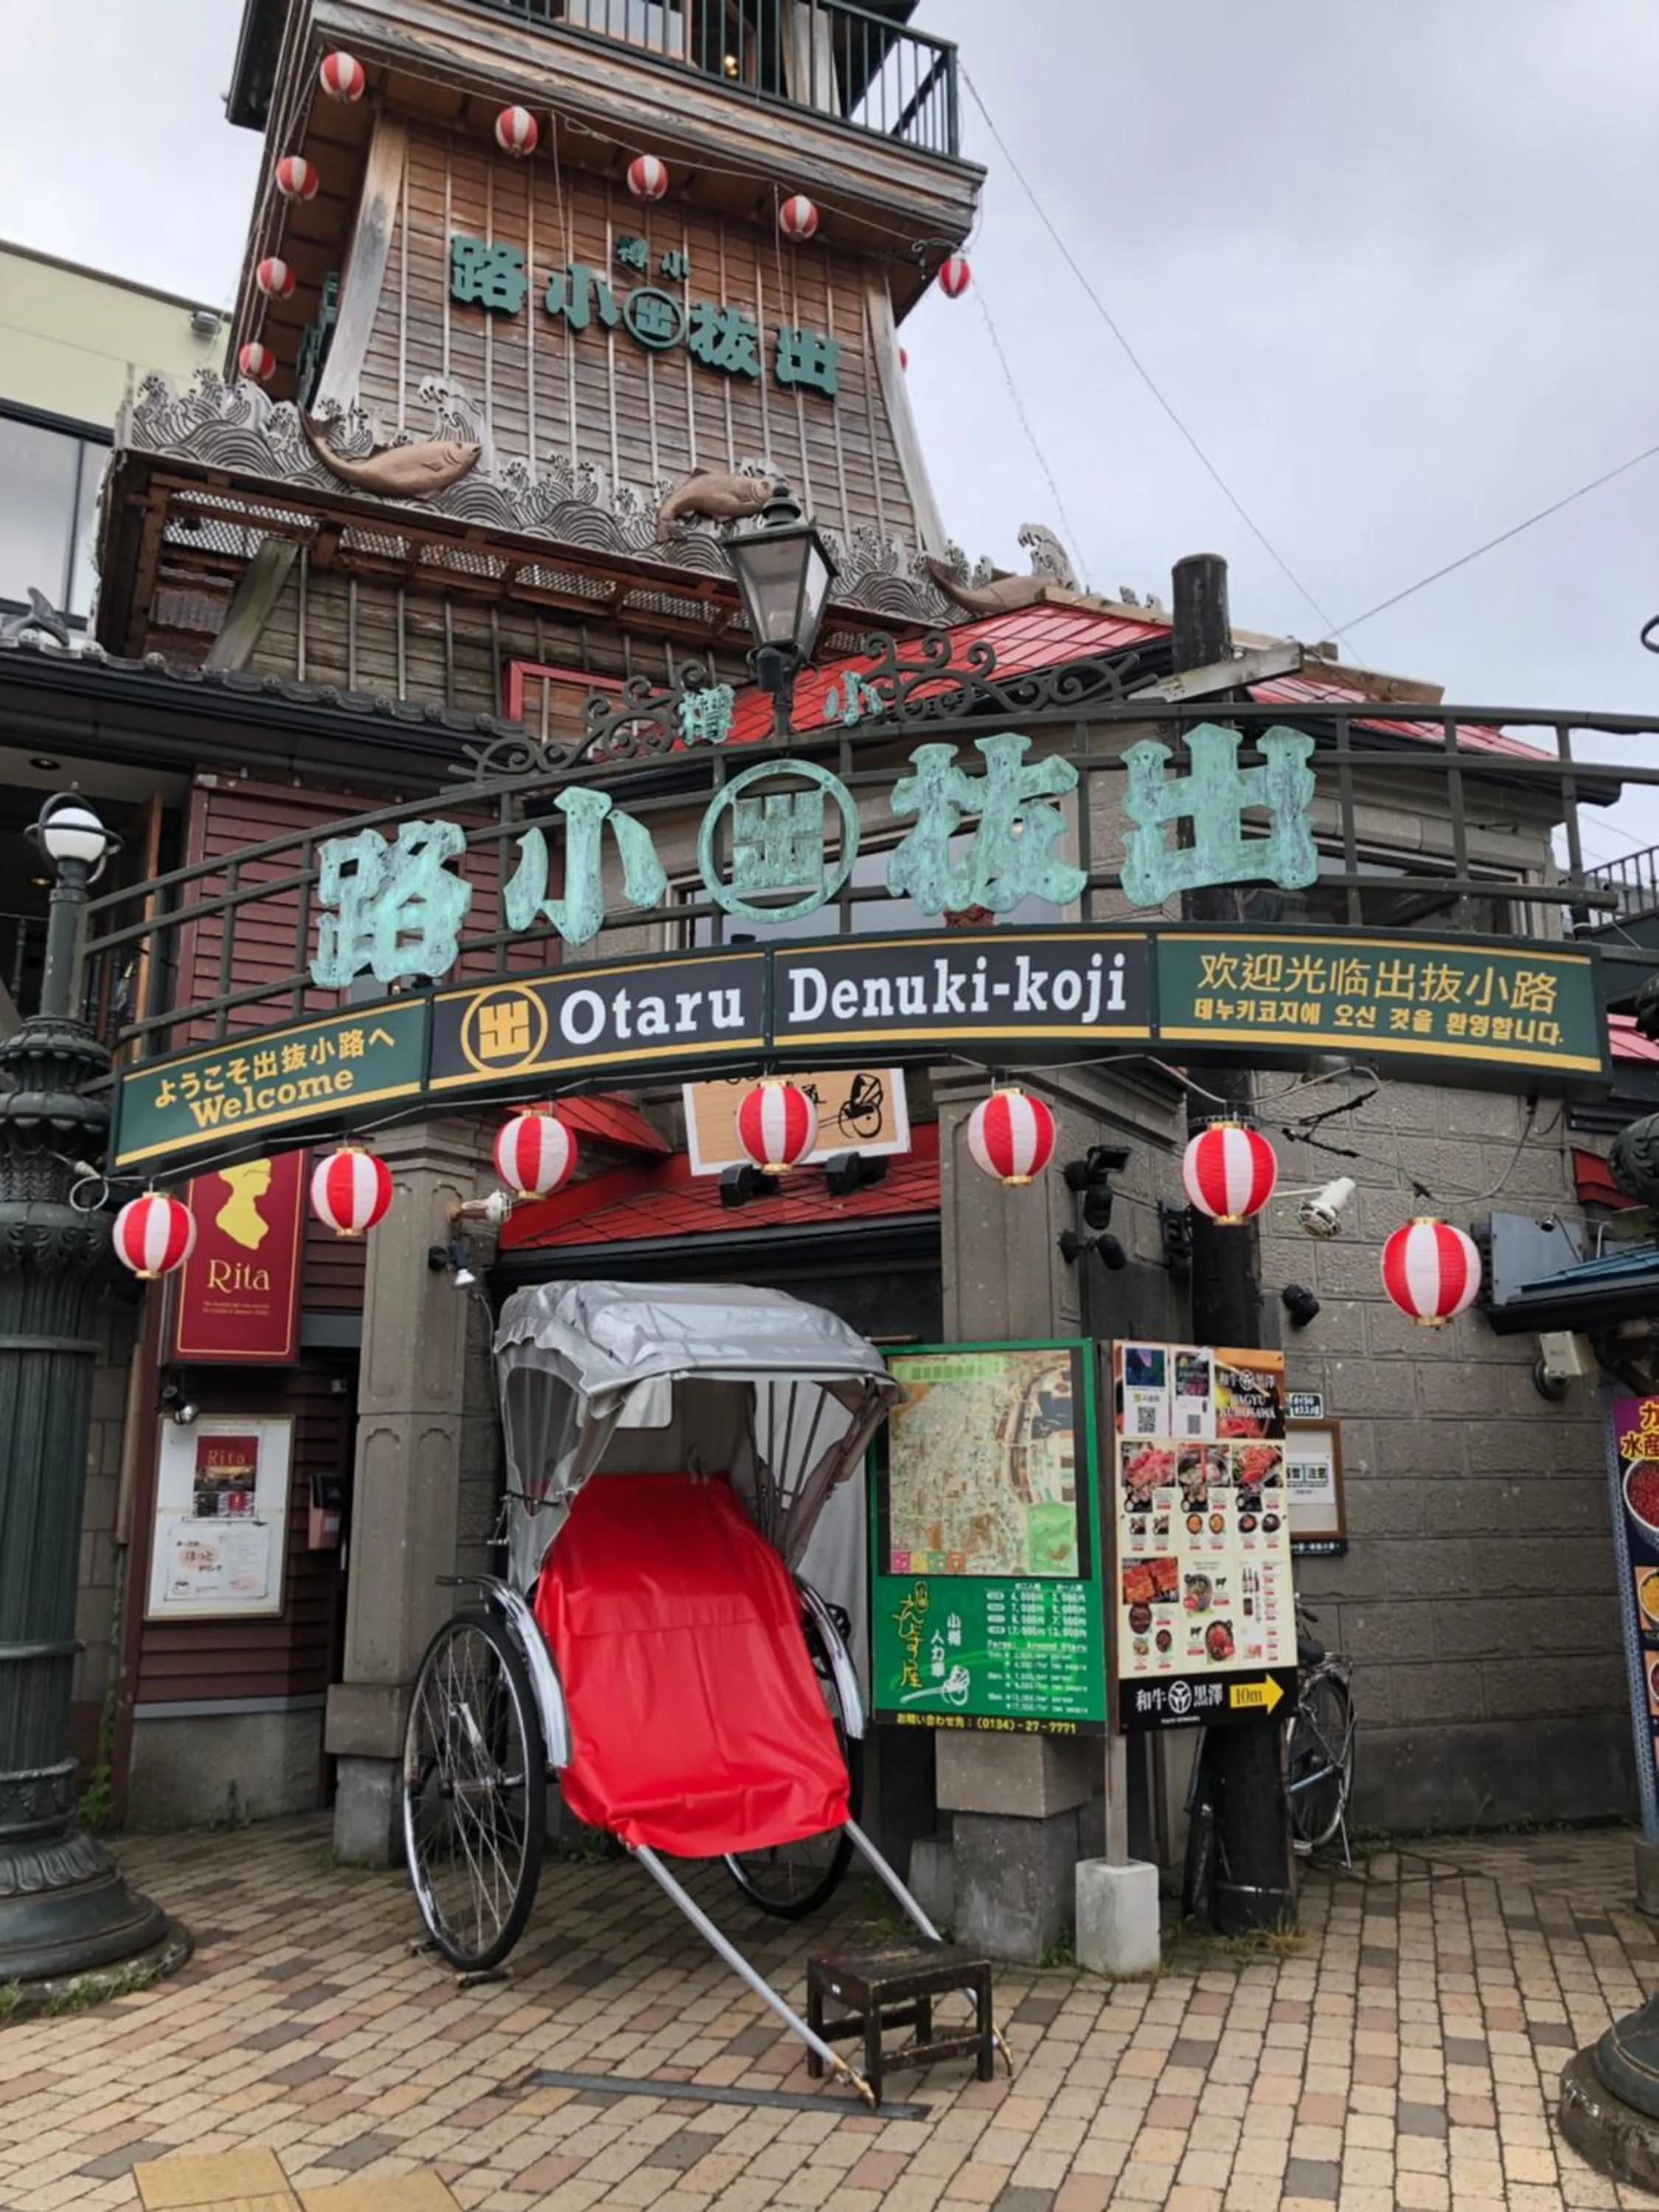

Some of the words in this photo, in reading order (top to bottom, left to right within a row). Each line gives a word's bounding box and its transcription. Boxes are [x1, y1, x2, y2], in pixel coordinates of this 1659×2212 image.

[560, 986, 745, 1046] Otaru
[787, 952, 1127, 1023] Denuki-koji
[1194, 998, 1321, 1026] 데누키코지에
[1333, 1004, 1377, 1029] 오신
[1389, 1008, 1433, 1034] 것을
[1446, 1012, 1564, 1046] 환영합니다.
[154, 1027, 395, 1108] ようこそ出抜小路へ
[189, 1068, 355, 1129] Welcome
[207, 1259, 271, 1293] Rita
[207, 1449, 246, 1466] Rita
[1135, 1688, 1166, 1712] 和牛
[1236, 1686, 1263, 1705] 10m
